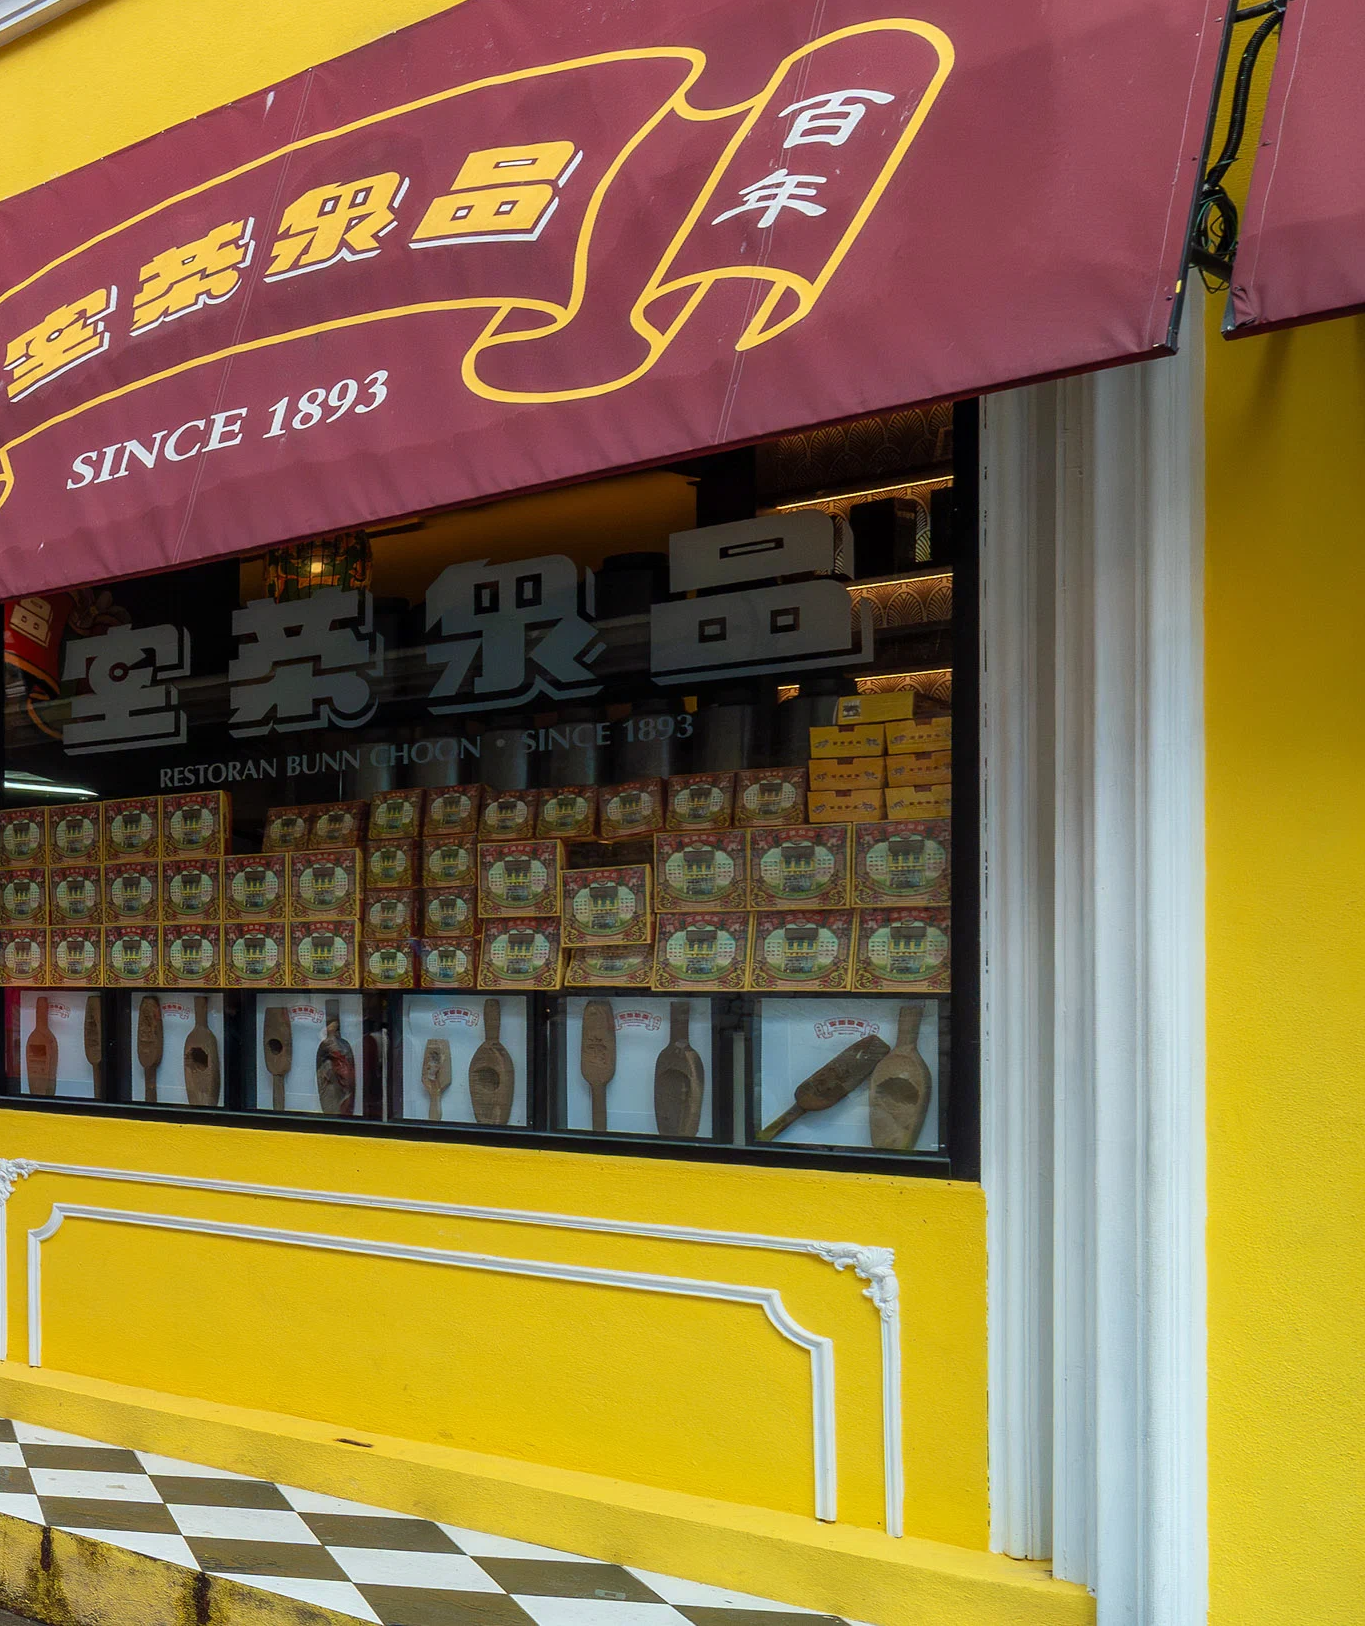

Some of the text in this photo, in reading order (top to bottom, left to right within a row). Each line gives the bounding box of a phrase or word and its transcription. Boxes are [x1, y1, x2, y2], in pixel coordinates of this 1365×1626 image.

[711, 87, 896, 229] 百年
[66, 369, 390, 491] SINCE 1893
[159, 714, 694, 789] RESTORAN BUNN CHOON SINCE 1893
